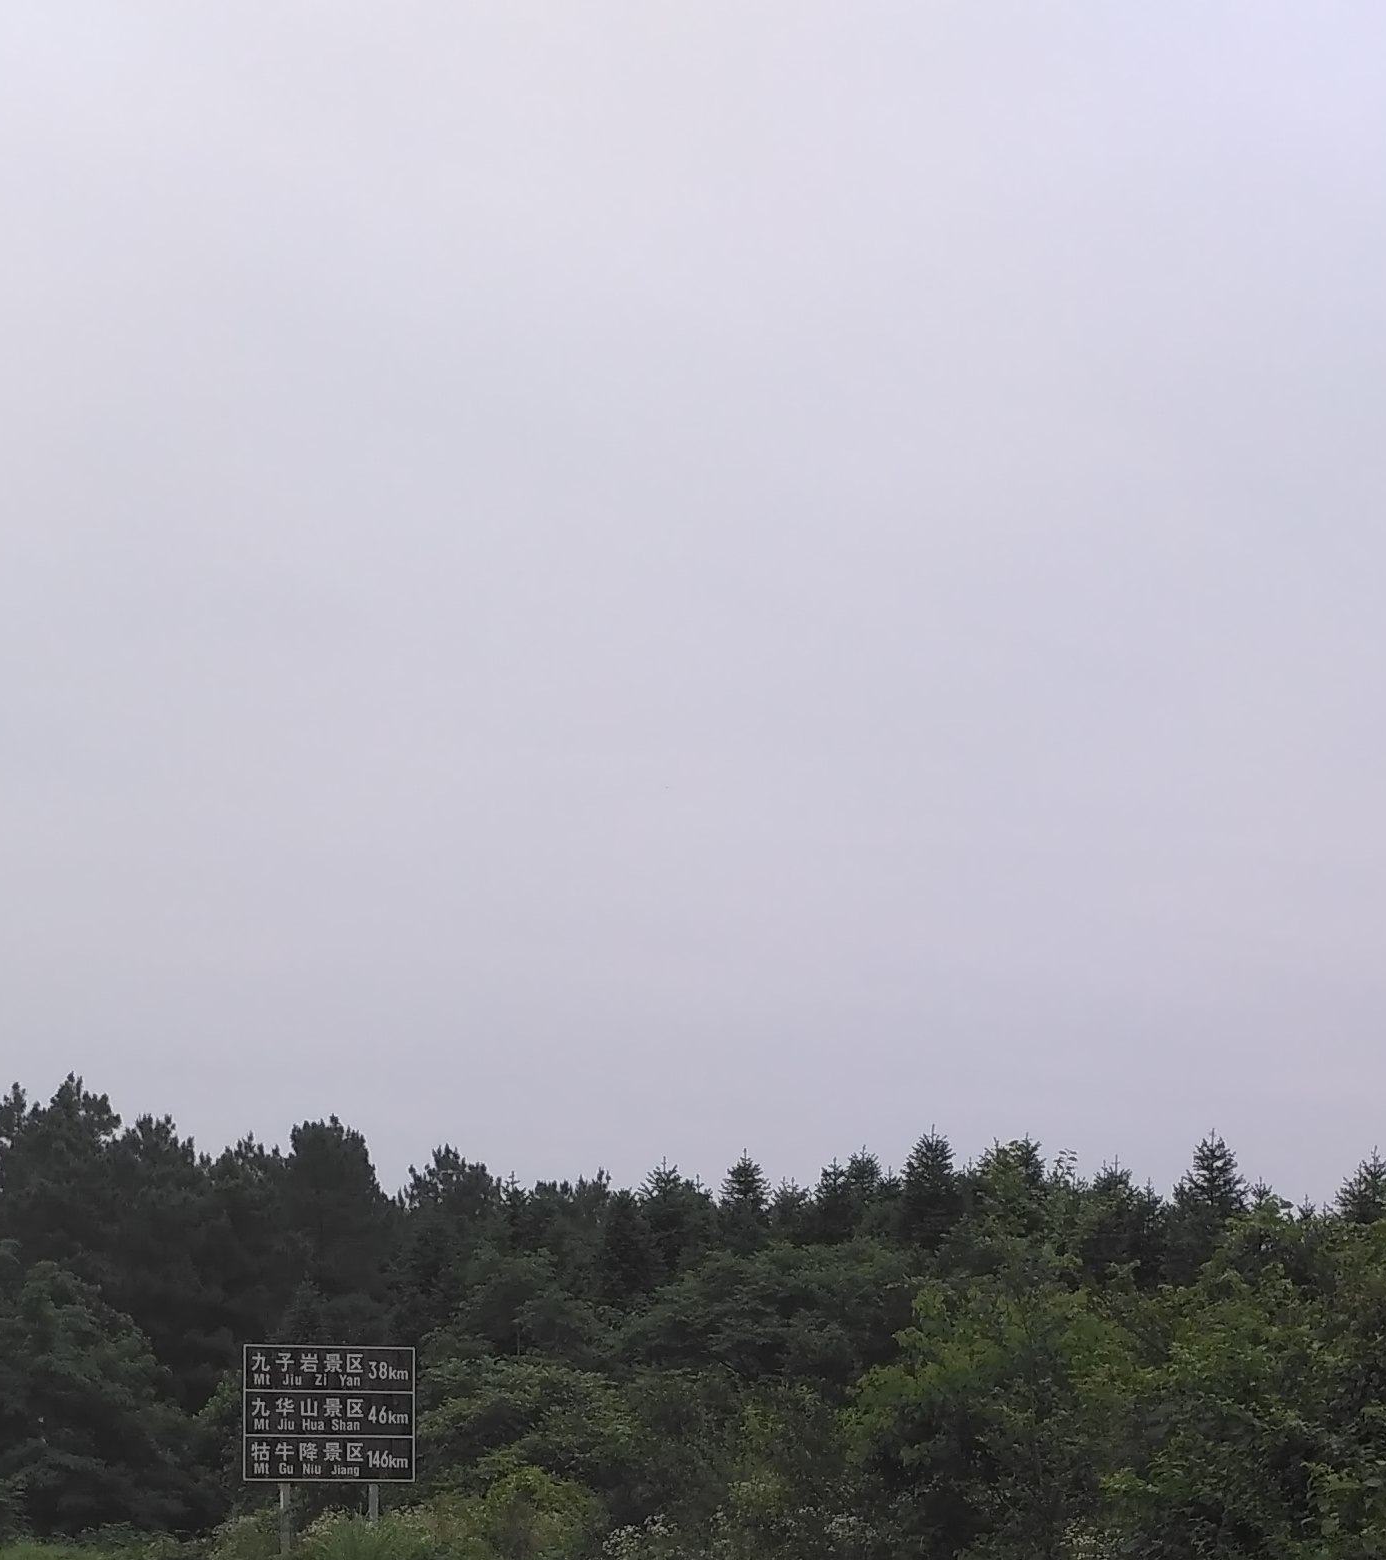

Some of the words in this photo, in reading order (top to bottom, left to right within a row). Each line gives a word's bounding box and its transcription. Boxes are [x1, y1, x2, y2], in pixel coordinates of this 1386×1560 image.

[251, 1353, 363, 1373] 九子岩景区
[368, 1361, 408, 1380] 38km
[254, 1374, 270, 1385] Mt
[283, 1375, 302, 1385] Jiu
[315, 1375, 327, 1385] Zi
[340, 1375, 361, 1386] Yan
[251, 1398, 363, 1418] 九华山景区
[368, 1406, 408, 1424] 46km
[254, 1420, 269, 1430] Mt
[278, 1420, 295, 1430] Jiu
[302, 1420, 324, 1430] Hua
[332, 1420, 360, 1431] Shan
[251, 1442, 363, 1461] 牯牛降景区
[367, 1451, 408, 1468] 146km
[254, 1464, 269, 1474] Mt
[279, 1464, 293, 1475] Gu
[303, 1464, 321, 1475] Niu
[331, 1465, 359, 1476] Jiang
